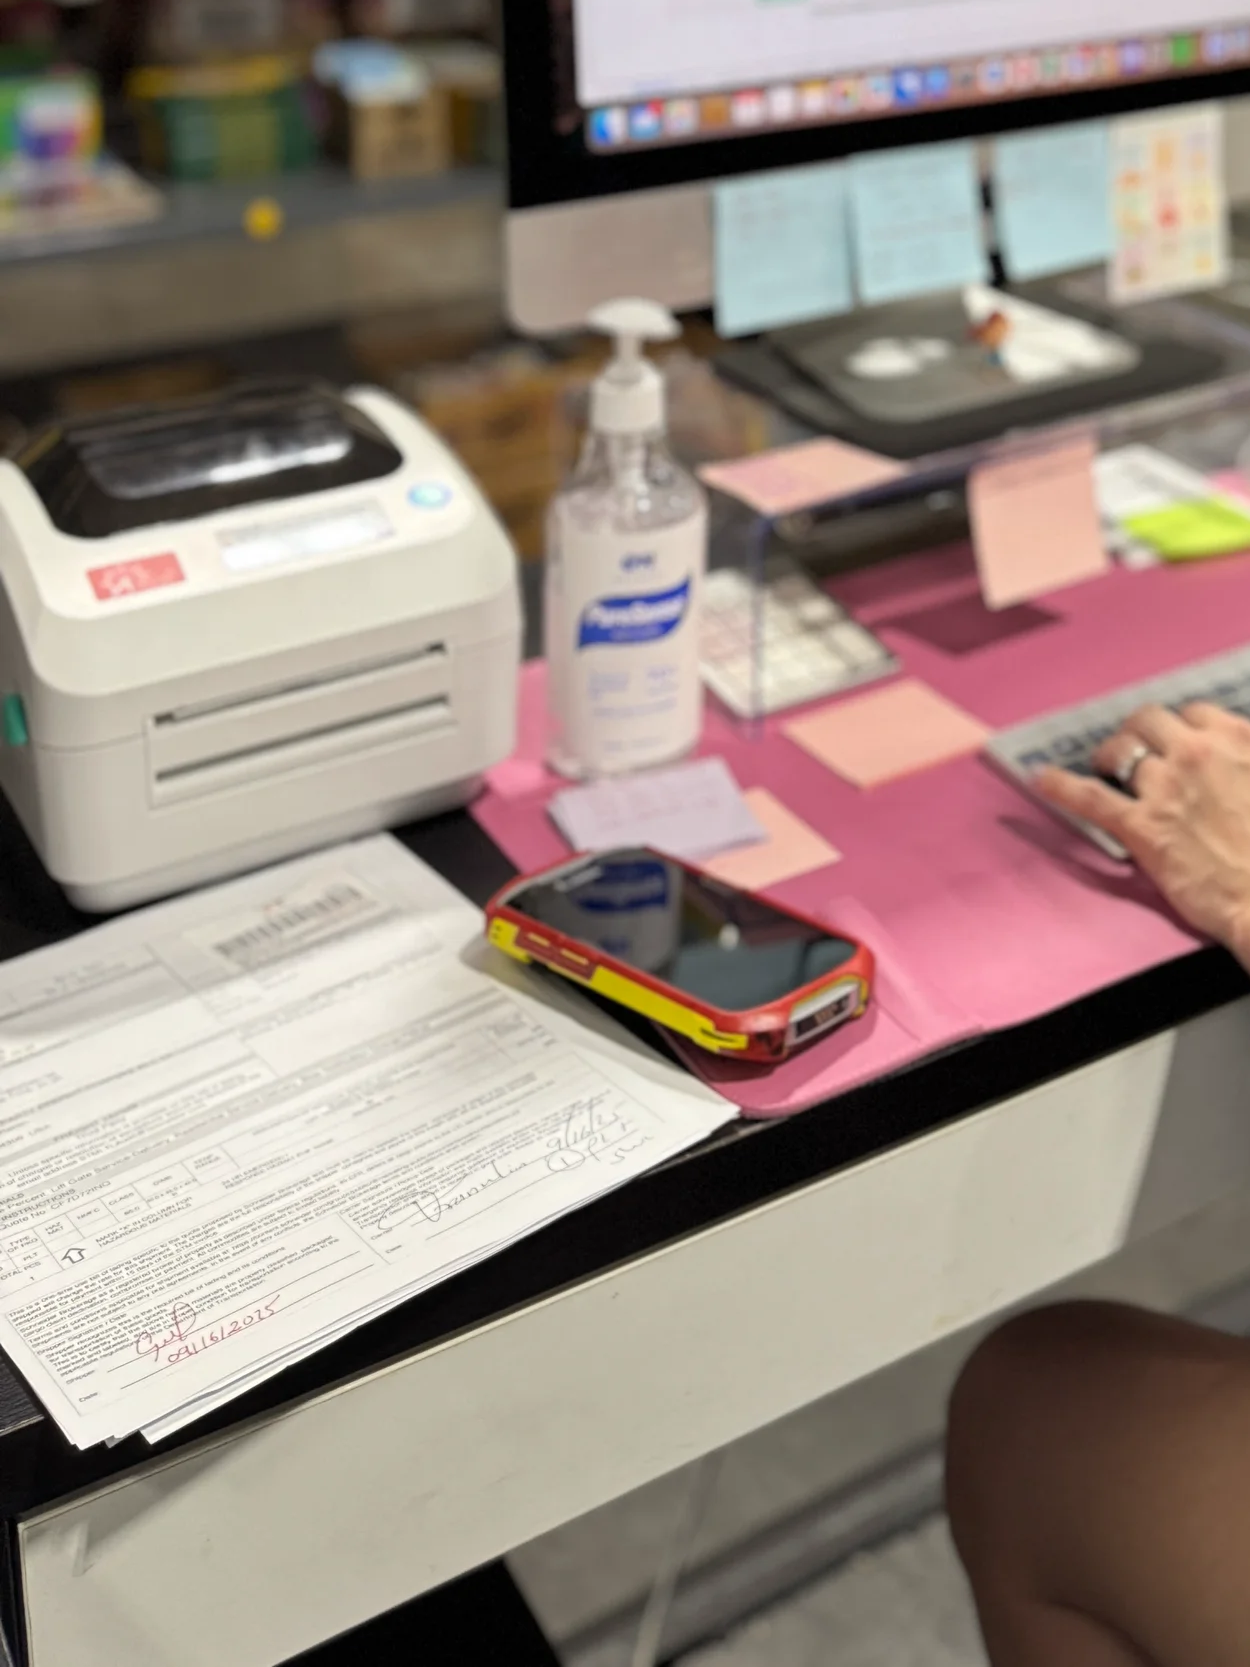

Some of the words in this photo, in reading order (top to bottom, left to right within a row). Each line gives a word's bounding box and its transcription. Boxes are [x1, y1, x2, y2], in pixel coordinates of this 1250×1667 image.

[16, 1163, 54, 1181] charges
[16, 1174, 41, 1187] email
[42, 1159, 77, 1176] address
[49, 1182, 66, 1192] Lift
[66, 1171, 93, 1185] Gate
[93, 1154, 131, 1173] Service
[0, 1186, 76, 1223] INSTRUCTIONS
[108, 1192, 135, 1206] CLASS
[347, 1204, 371, 1217] Carrier
[361, 1186, 394, 1203] Signature
[44, 1221, 62, 1231] HAZ
[98, 1222, 148, 1247] HAZARDOUS
[147, 1202, 192, 1224] MATERIALS
[351, 1203, 387, 1222] emergency
[9, 1235, 30, 1246] TYPE
[47, 1225, 65, 1235] MAT
[95, 1230, 119, 1242] MARK
[0, 1267, 23, 1281] OTAL
[23, 1260, 41, 1271] PCS
[8, 1307, 25, 1317] This
[108, 1259, 132, 1272] lading
[167, 1236, 180, 1244] the
[180, 1227, 201, 1239] quote
[200, 1211, 235, 1229] proposed
[22, 1251, 39, 1261] PLT
[12, 1306, 43, 1323] shipped
[55, 1287, 84, 1303] change
[84, 1281, 96, 1289] the
[97, 1273, 113, 1283] rate
[174, 1239, 188, 1247] The
[187, 1225, 217, 1241] charges
[15, 1304, 59, 1327] responsible
[69, 1284, 102, 1302] payment
[102, 1274, 124, 1286] within
[135, 1260, 154, 1272] days
[162, 1251, 175, 1259] the
[174, 1242, 192, 1253] STM
[19, 1313, 57, 1333] Schneider
[58, 1295, 97, 1316] Brokerage
[114, 1270, 151, 1290] registered
[183, 1242, 213, 1258] property
[222, 1221, 257, 1239] described
[22, 1325, 46, 1338] Cargo
[109, 1275, 154, 1299] compromise
[206, 1230, 250, 1252] commodities
[250, 1224, 263, 1232] are
[28, 1330, 53, 1344] Terms
[53, 1323, 69, 1333] and
[69, 1305, 107, 1325] conditions
[107, 1288, 145, 1309] applicable
[155, 1267, 190, 1286] shipment
[189, 1252, 221, 1269] available
[31, 1327, 72, 1350] Shipments
[72, 1322, 86, 1330] are
[86, 1315, 99, 1324] not
[99, 1303, 127, 1318] subject
[136, 1293, 150, 1302] any
[218, 1254, 231, 1262] the
[230, 1245, 251, 1256] event
[259, 1235, 274, 1243] any
[56, 1356, 85, 1372] marked
[86, 1349, 101, 1359] and
[194, 1291, 227, 1309] condition
[227, 1285, 238, 1293] for
[238, 1262, 287, 1288] transportation
[286, 1246, 320, 1265] according
[327, 1237, 339, 1245] the
[45, 1342, 76, 1360] Shipper
[76, 1324, 118, 1346] recognizes
[117, 1317, 132, 1326] this
[140, 1307, 153, 1316] the
[153, 1293, 184, 1311] required
[203, 1273, 227, 1287] lading
[226, 1266, 241, 1275] and
[53, 1357, 70, 1367] This
[87, 1338, 112, 1353] certify
[112, 1331, 127, 1341] that
[127, 1325, 140, 1334] the
[140, 1314, 164, 1328] above
[190, 1287, 223, 1305] materials
[224, 1281, 236, 1289] are
[236, 1267, 266, 1283] properly
[36, 1339, 67, 1356] Shipper
[67, 1323, 104, 1343] Signature
[108, 1312, 127, 1323] Date
[49, 1355, 60, 1363] for
[61, 1331, 113, 1359] transportation
[122, 1318, 143, 1330] these
[59, 1356, 99, 1378] applicable
[65, 1368, 96, 1386] Shipper
[78, 1390, 98, 1403] Date
